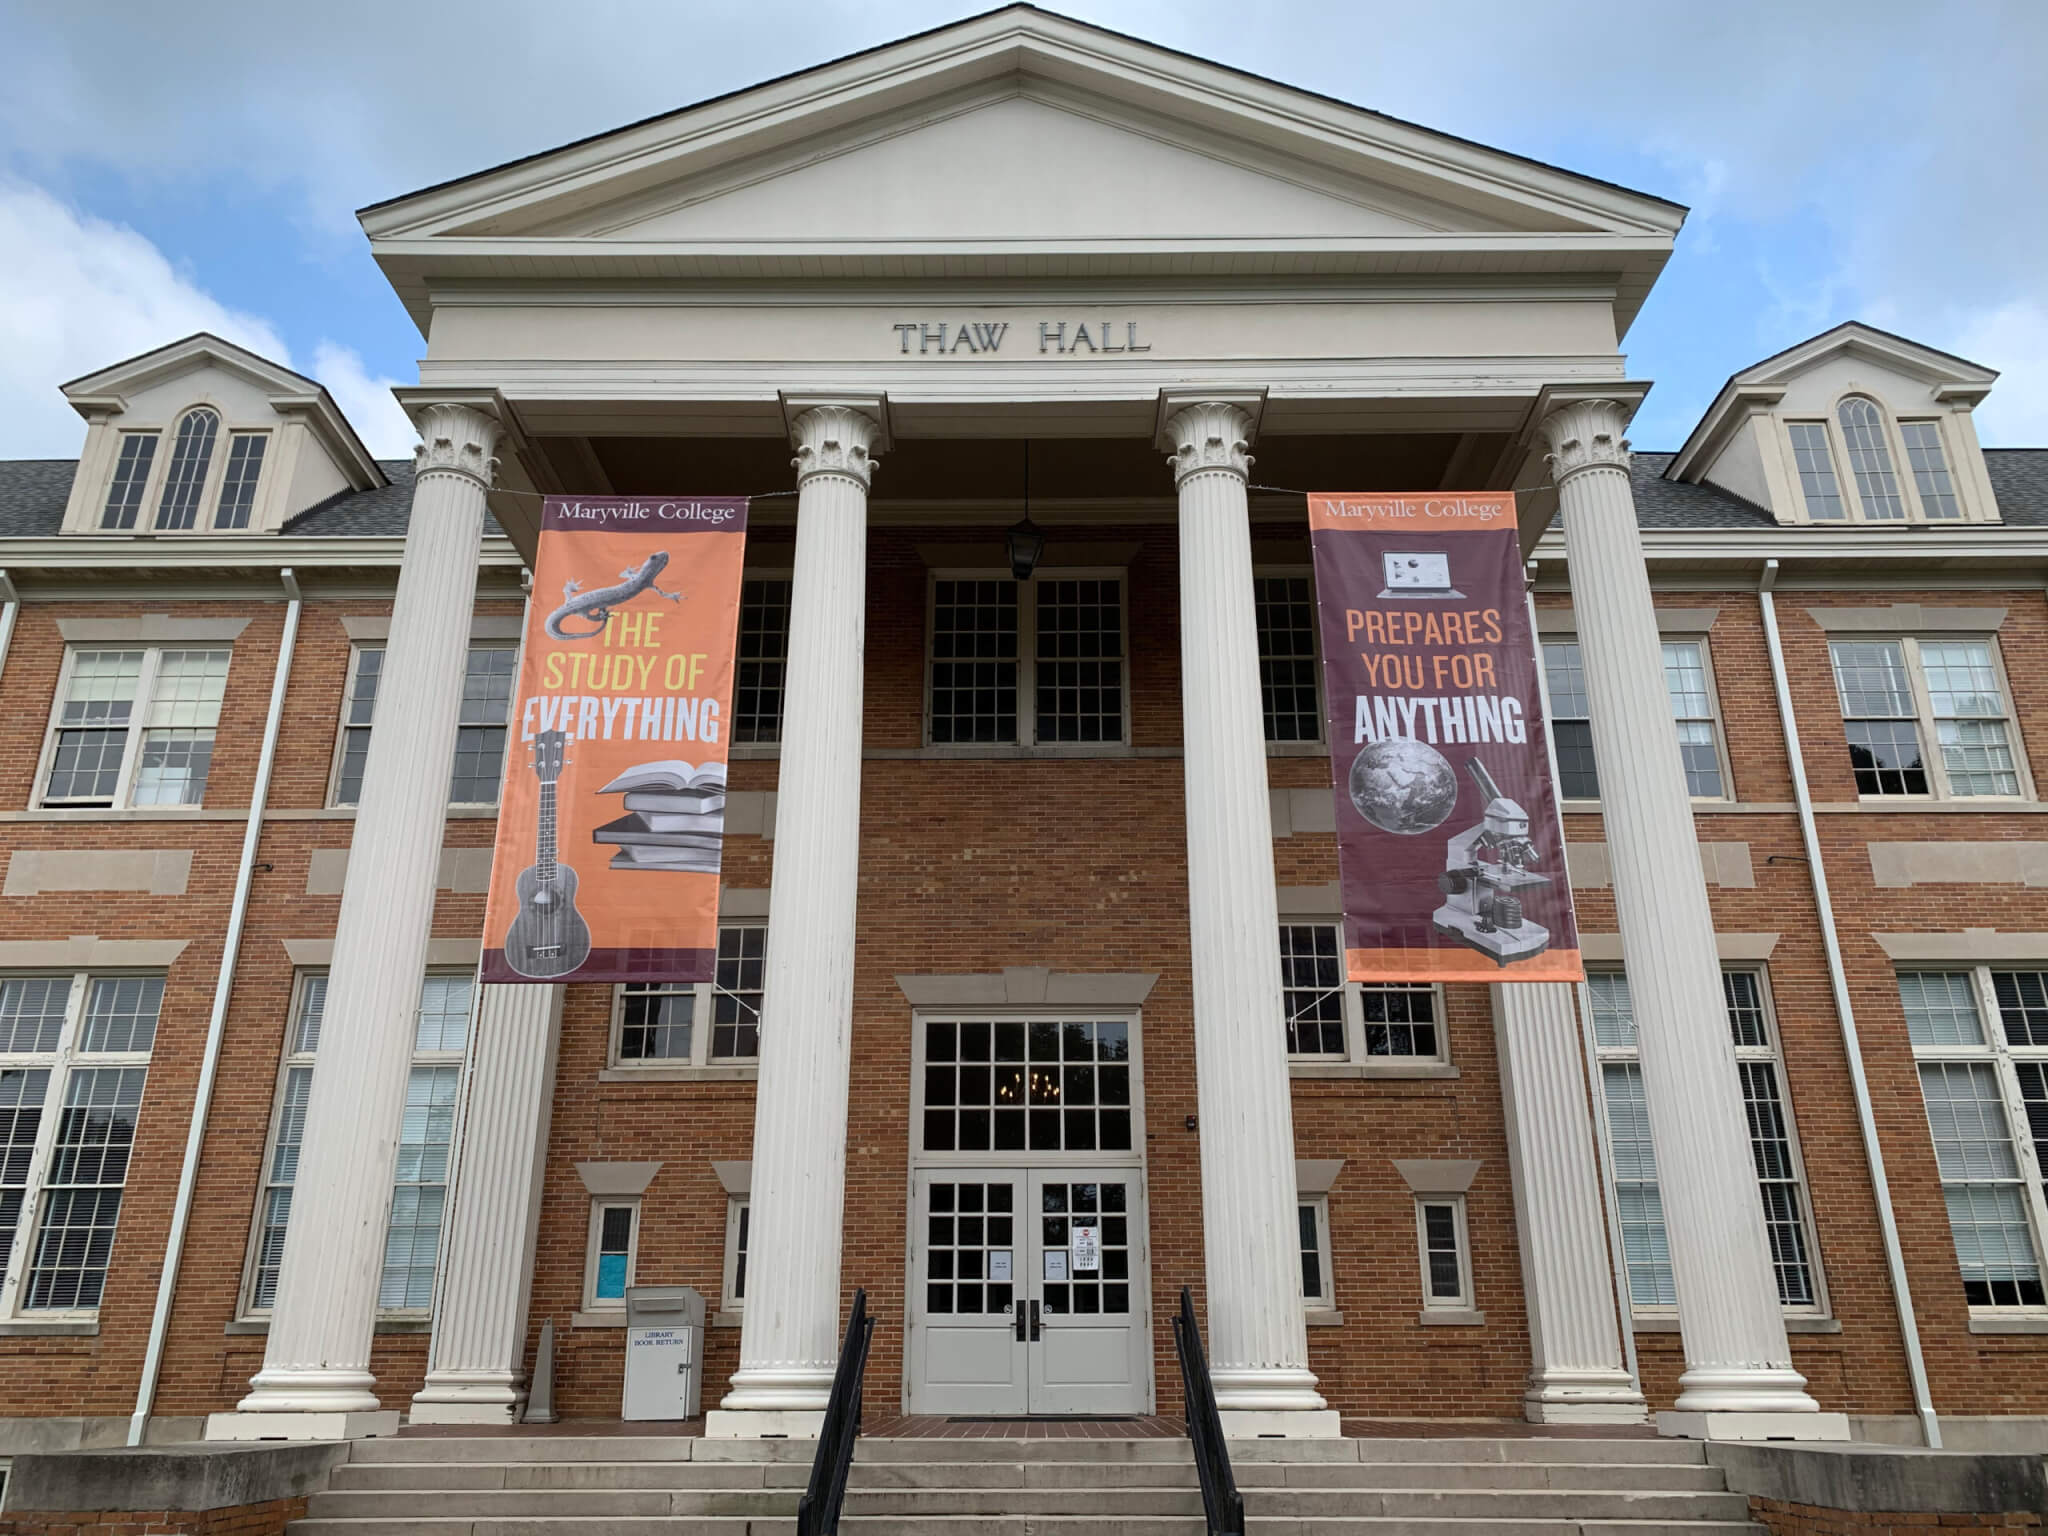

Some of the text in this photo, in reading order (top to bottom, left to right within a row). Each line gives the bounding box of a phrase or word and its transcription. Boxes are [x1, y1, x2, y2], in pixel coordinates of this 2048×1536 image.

[894, 322, 1151, 353] THAW HALL
[558, 502, 736, 524] Maryville College
[1325, 500, 1503, 521] Maryville College
[604, 611, 665, 648] THE
[1346, 608, 1503, 645] PREPARES
[543, 652, 708, 691] STUDY OF
[1361, 653, 1497, 690] YOU FOR
[520, 695, 720, 744] EVERYTHING
[1354, 695, 1528, 744] ANYTHING
